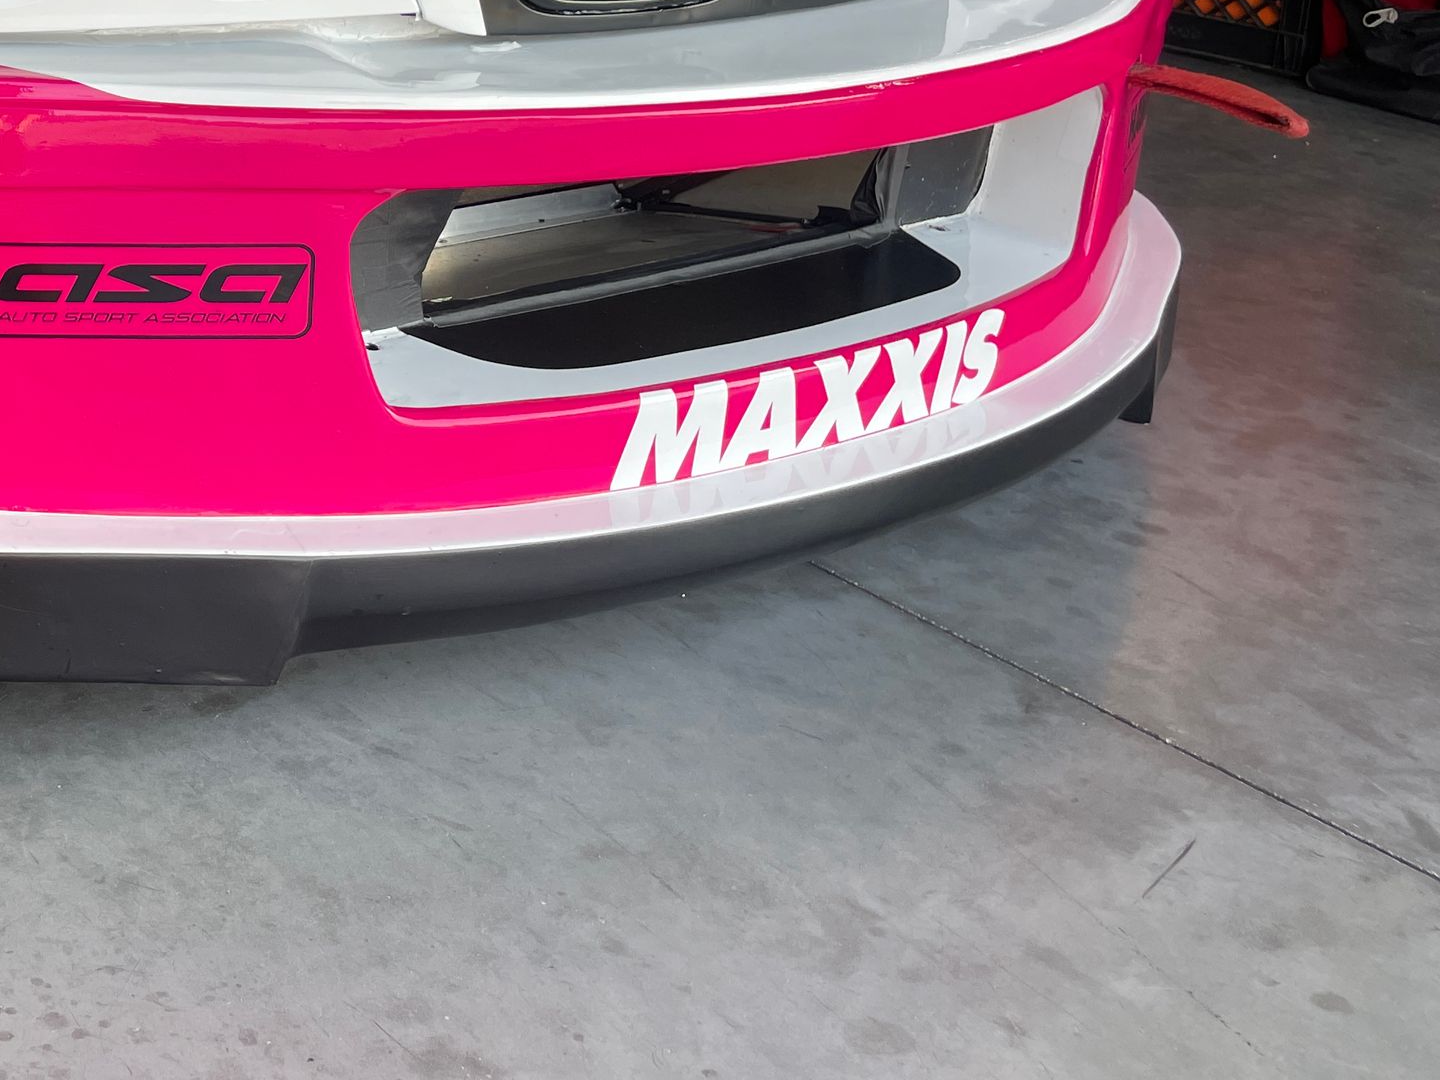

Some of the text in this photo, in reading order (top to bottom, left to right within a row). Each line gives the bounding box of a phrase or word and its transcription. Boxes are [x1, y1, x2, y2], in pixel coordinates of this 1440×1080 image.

[63, 312, 138, 324] SPORT
[143, 312, 287, 325] ASSOCIATION
[610, 308, 1006, 491] MAXXIS
